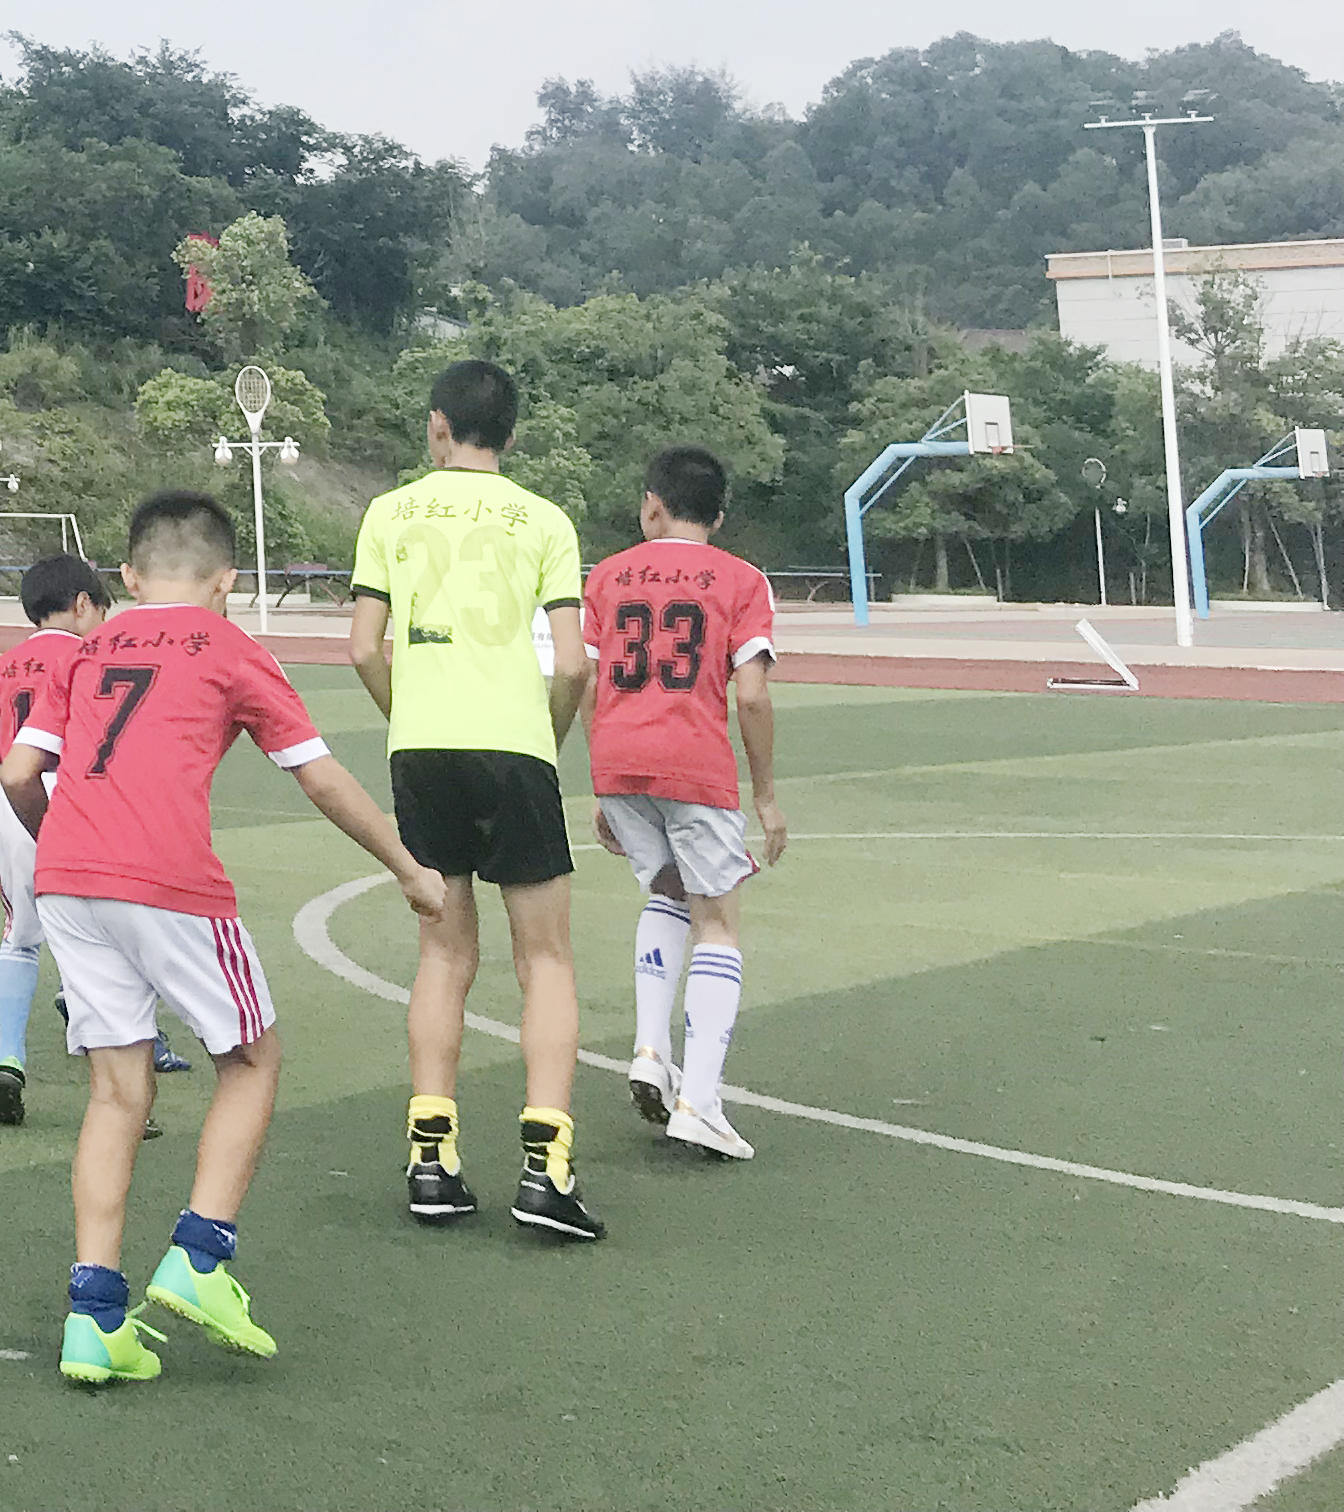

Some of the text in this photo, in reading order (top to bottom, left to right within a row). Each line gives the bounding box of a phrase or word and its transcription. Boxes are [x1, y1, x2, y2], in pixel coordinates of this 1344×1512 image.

[391, 496, 529, 536] 培红小学
[610, 599, 707, 693] 33
[84, 664, 161, 779] 7
